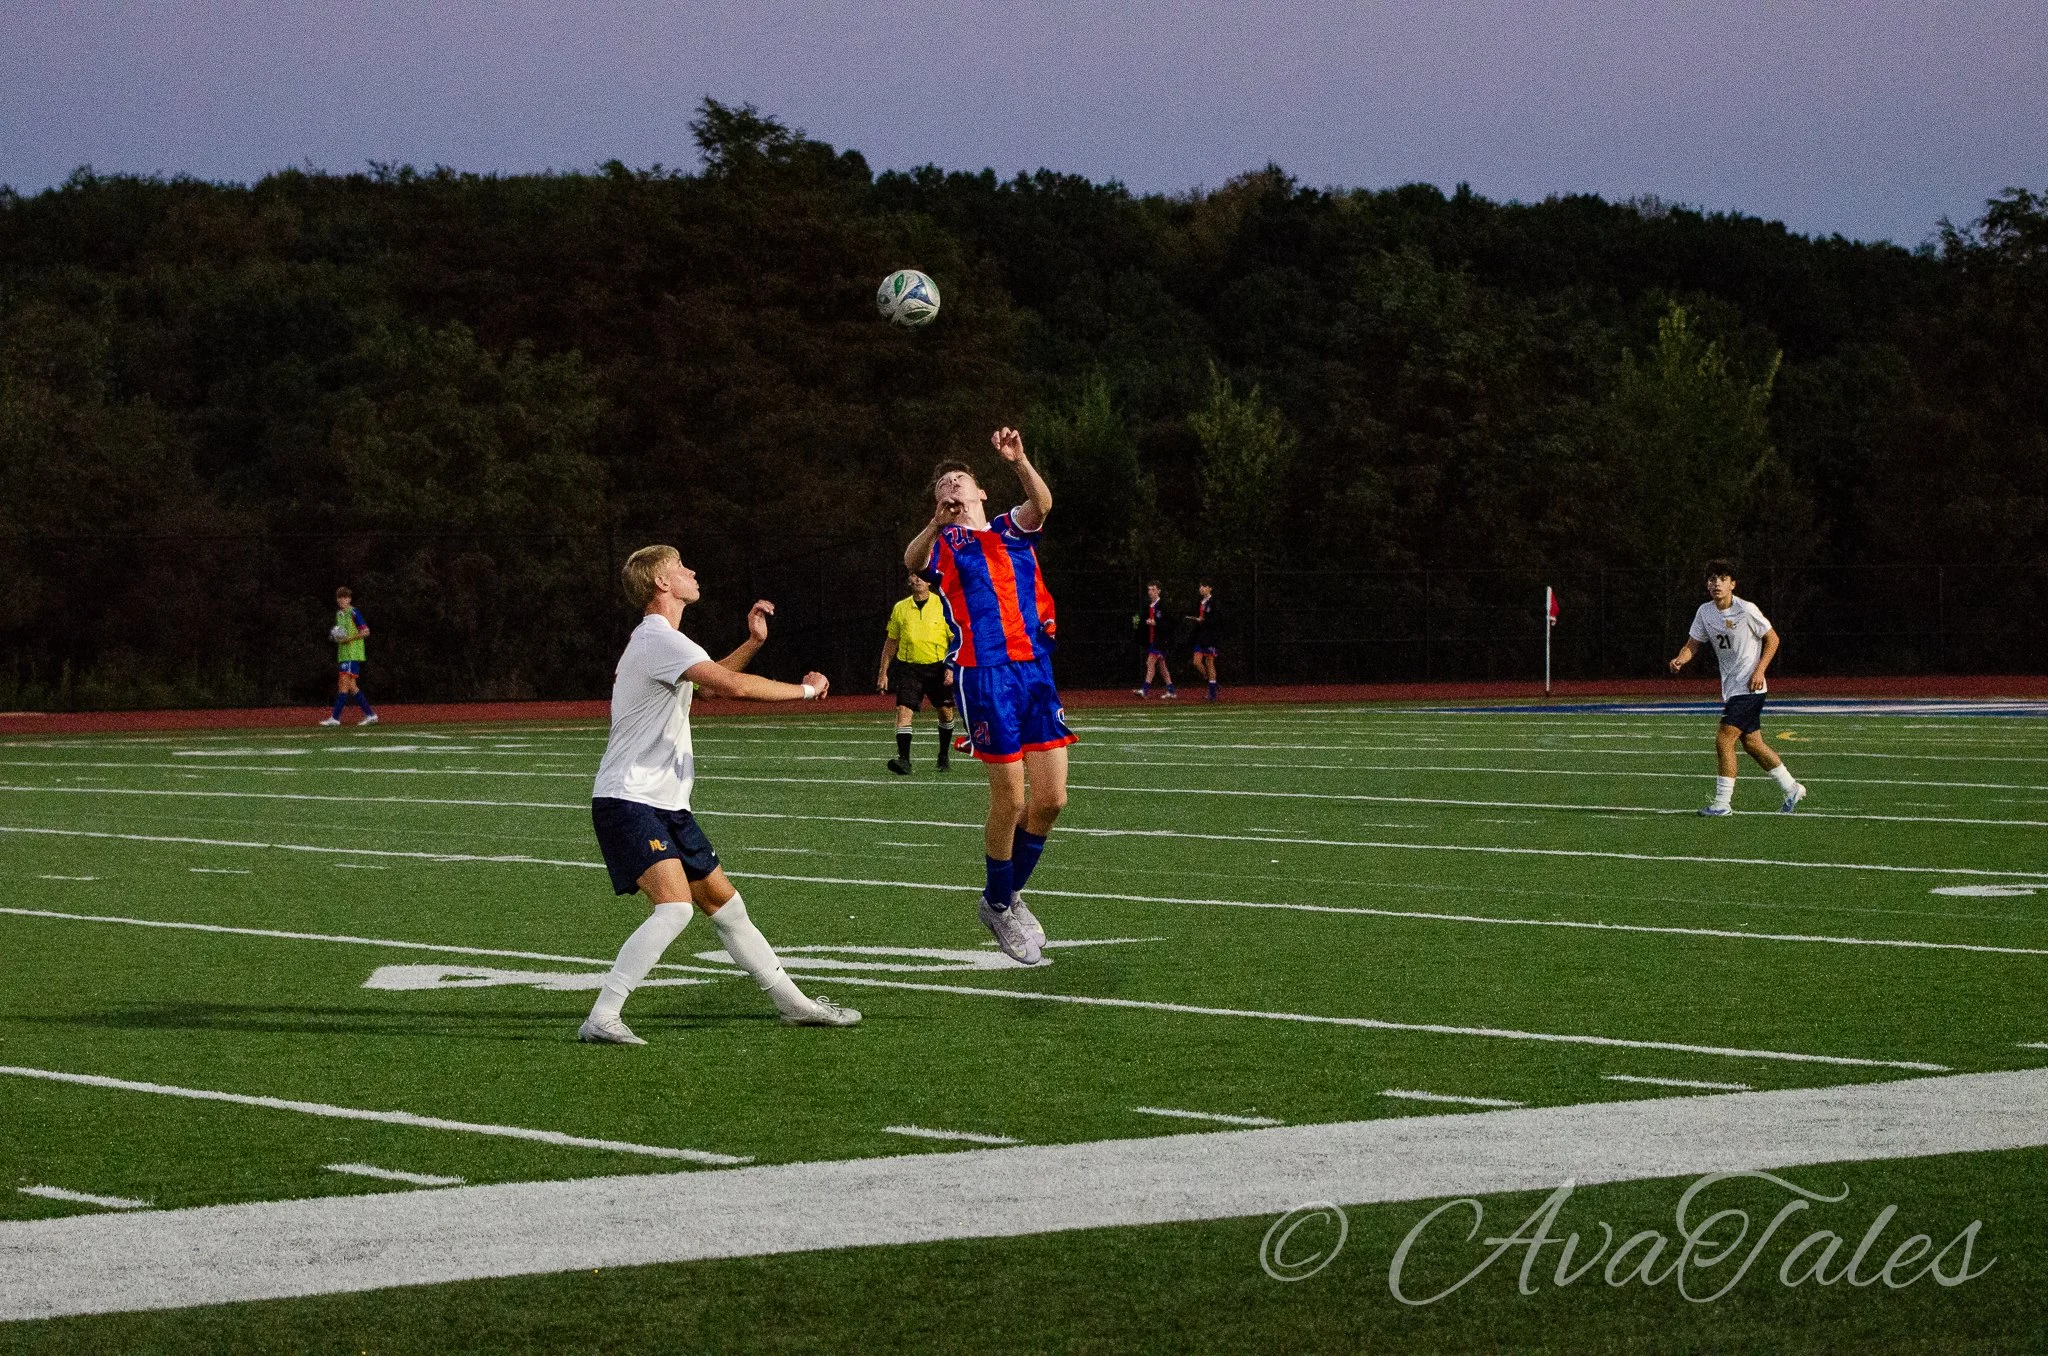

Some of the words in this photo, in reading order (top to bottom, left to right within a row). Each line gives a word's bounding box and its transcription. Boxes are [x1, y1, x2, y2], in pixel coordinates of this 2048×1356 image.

[942, 526, 976, 551] 21
[1716, 633, 1731, 649] 21
[974, 719, 991, 745] 21
